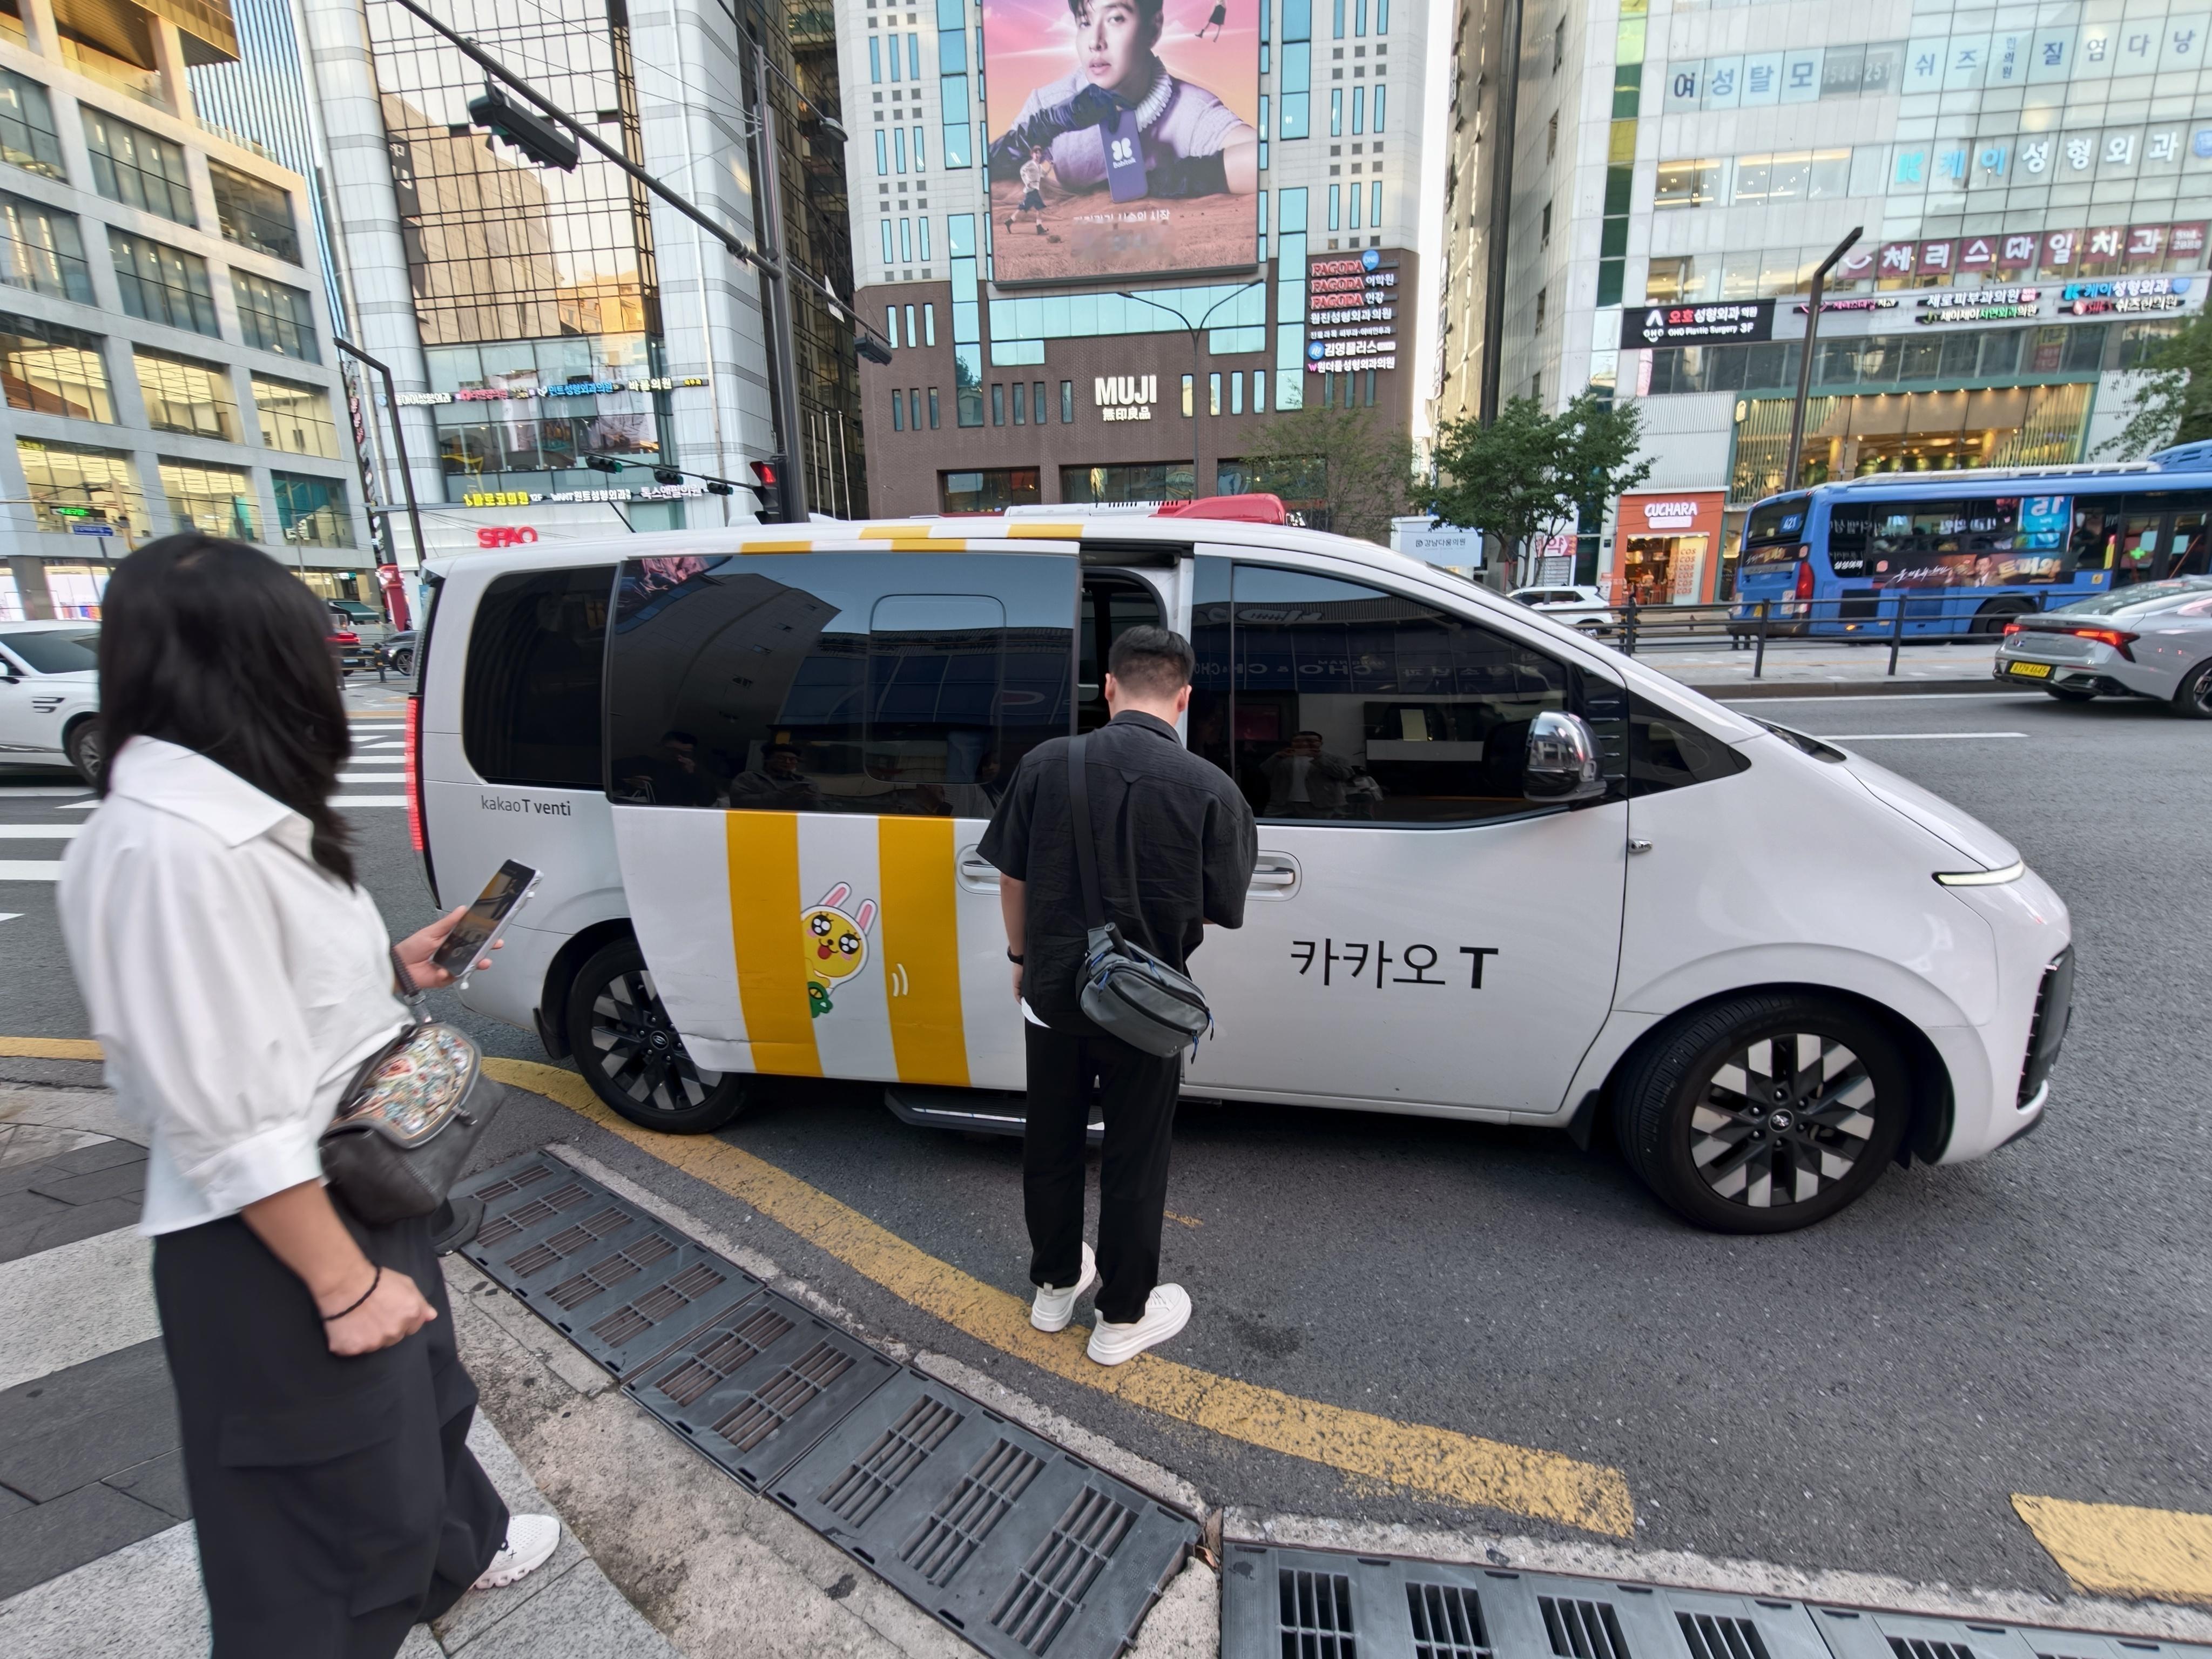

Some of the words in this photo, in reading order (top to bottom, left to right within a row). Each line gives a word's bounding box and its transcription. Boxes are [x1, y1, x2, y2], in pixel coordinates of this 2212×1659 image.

[1674, 61, 1815, 98] 여성탈모
[1311, 260, 1365, 277] PAGODA
[1364, 255, 1377, 264] ONE
[1311, 276, 1365, 294] PAGODA
[2084, 278, 2170, 298] 케이성형외과
[1311, 293, 1365, 310] PAGODA
[1365, 292, 1384, 305] 인강
[1311, 307, 1392, 325] 원진성형외과의원
[1685, 325, 1709, 336] Plastic
[1709, 324, 1738, 335] Surgery
[1740, 322, 1754, 334] 3F
[1324, 340, 1377, 358] 김영플러스
[1095, 374, 1157, 406] MUJI
[1102, 406, 1151, 422] 無印良品
[1643, 502, 1698, 517] CUCHARA
[476, 526, 539, 548] SPAO
[534, 800, 571, 817] venti
[1290, 938, 1446, 989] 카카오
[1459, 946, 1500, 990] T
